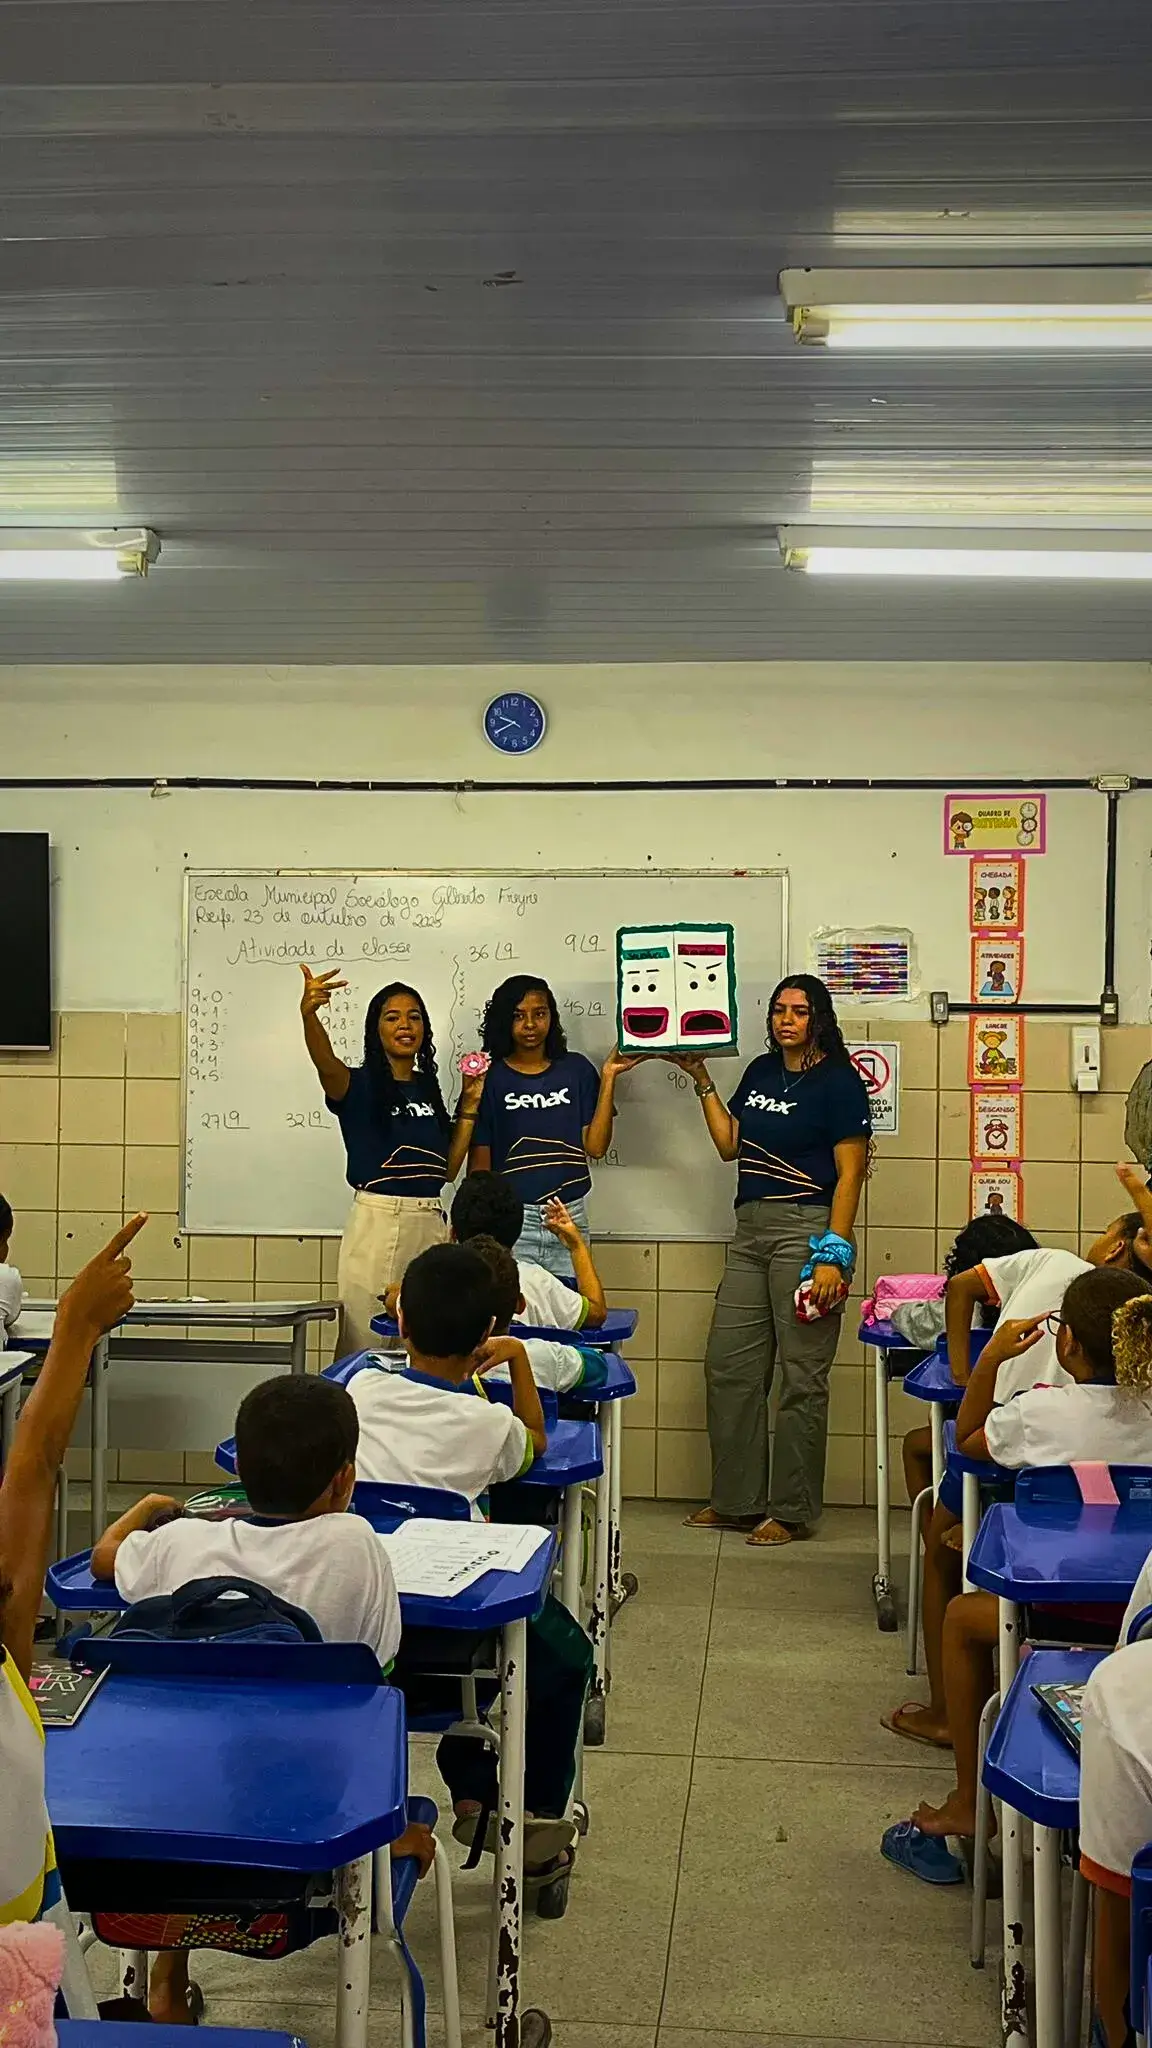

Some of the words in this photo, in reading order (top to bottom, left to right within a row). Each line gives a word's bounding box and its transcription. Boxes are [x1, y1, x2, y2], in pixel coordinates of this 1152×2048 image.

[502, 699, 509, 709] 11
[510, 697, 519, 707] 12
[523, 700, 526, 708] 1
[493, 707, 502, 716] 10
[530, 707, 536, 717] 2
[490, 718, 496, 727] 9
[534, 718, 539, 728] 3
[530, 728, 535, 737] 4
[502, 736, 508, 745] 7
[511, 738, 518, 748] 6
[522, 736, 528, 746] 5
[243, 908, 264, 924] 23
[273, 907, 291, 922] de
[301, 906, 367, 927] outubro
[380, 909, 395, 927] de
[227, 937, 316, 965] Atividade
[326, 939, 344, 957] de
[362, 937, 412, 956] classe
[667, 1071, 688, 1090] 90
[201, 1112, 220, 1129] 27
[286, 1112, 306, 1128] 32
